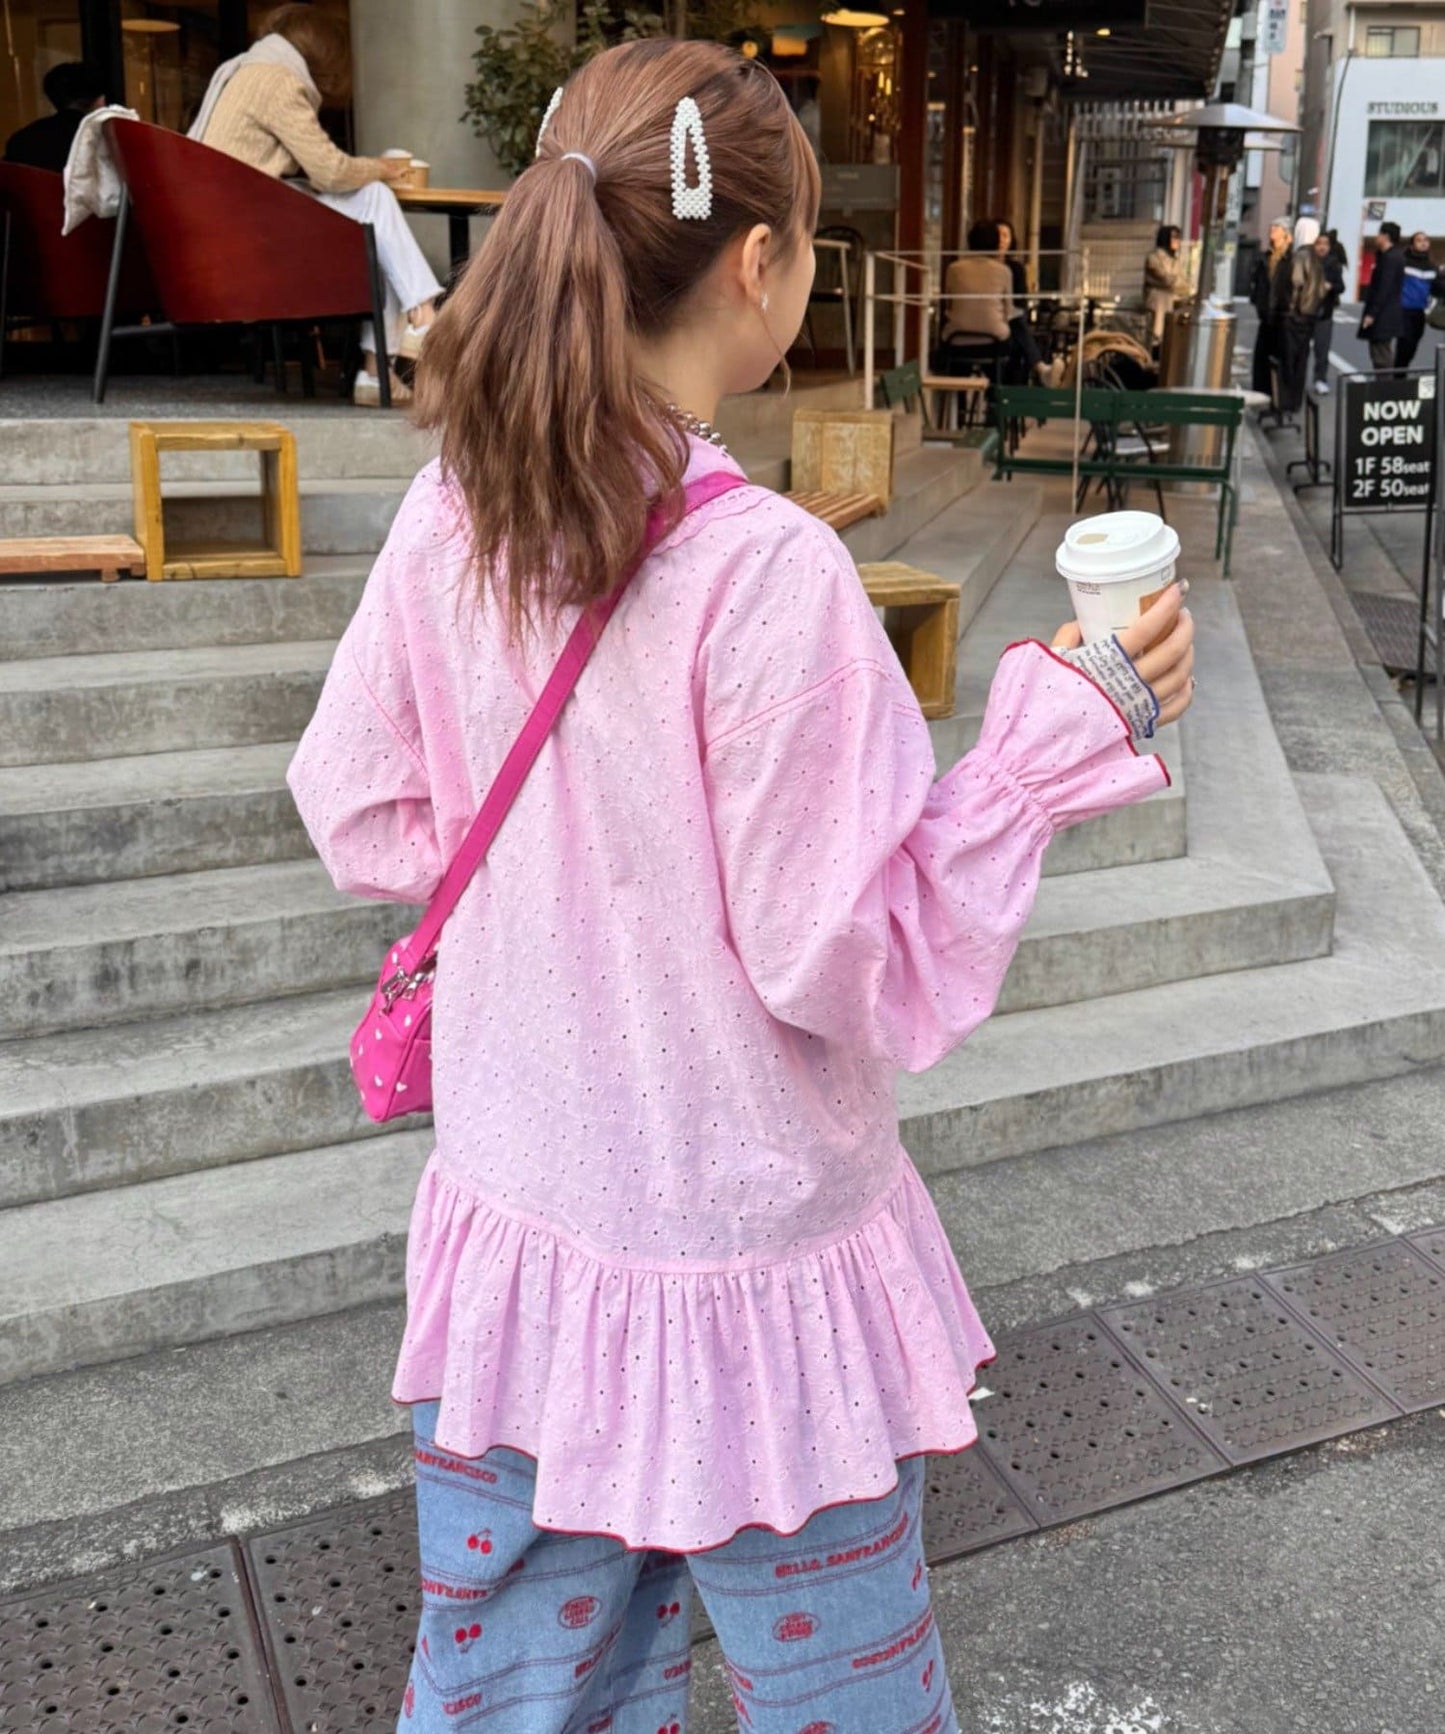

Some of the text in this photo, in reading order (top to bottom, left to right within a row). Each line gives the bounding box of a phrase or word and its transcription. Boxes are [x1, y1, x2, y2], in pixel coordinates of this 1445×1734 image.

[1367, 101, 1438, 115] STUDIOUS
[1363, 400, 1422, 421] NOW
[1361, 425, 1424, 446] OPEN
[1355, 456, 1376, 475] 1F
[1353, 479, 1375, 498] 2F
